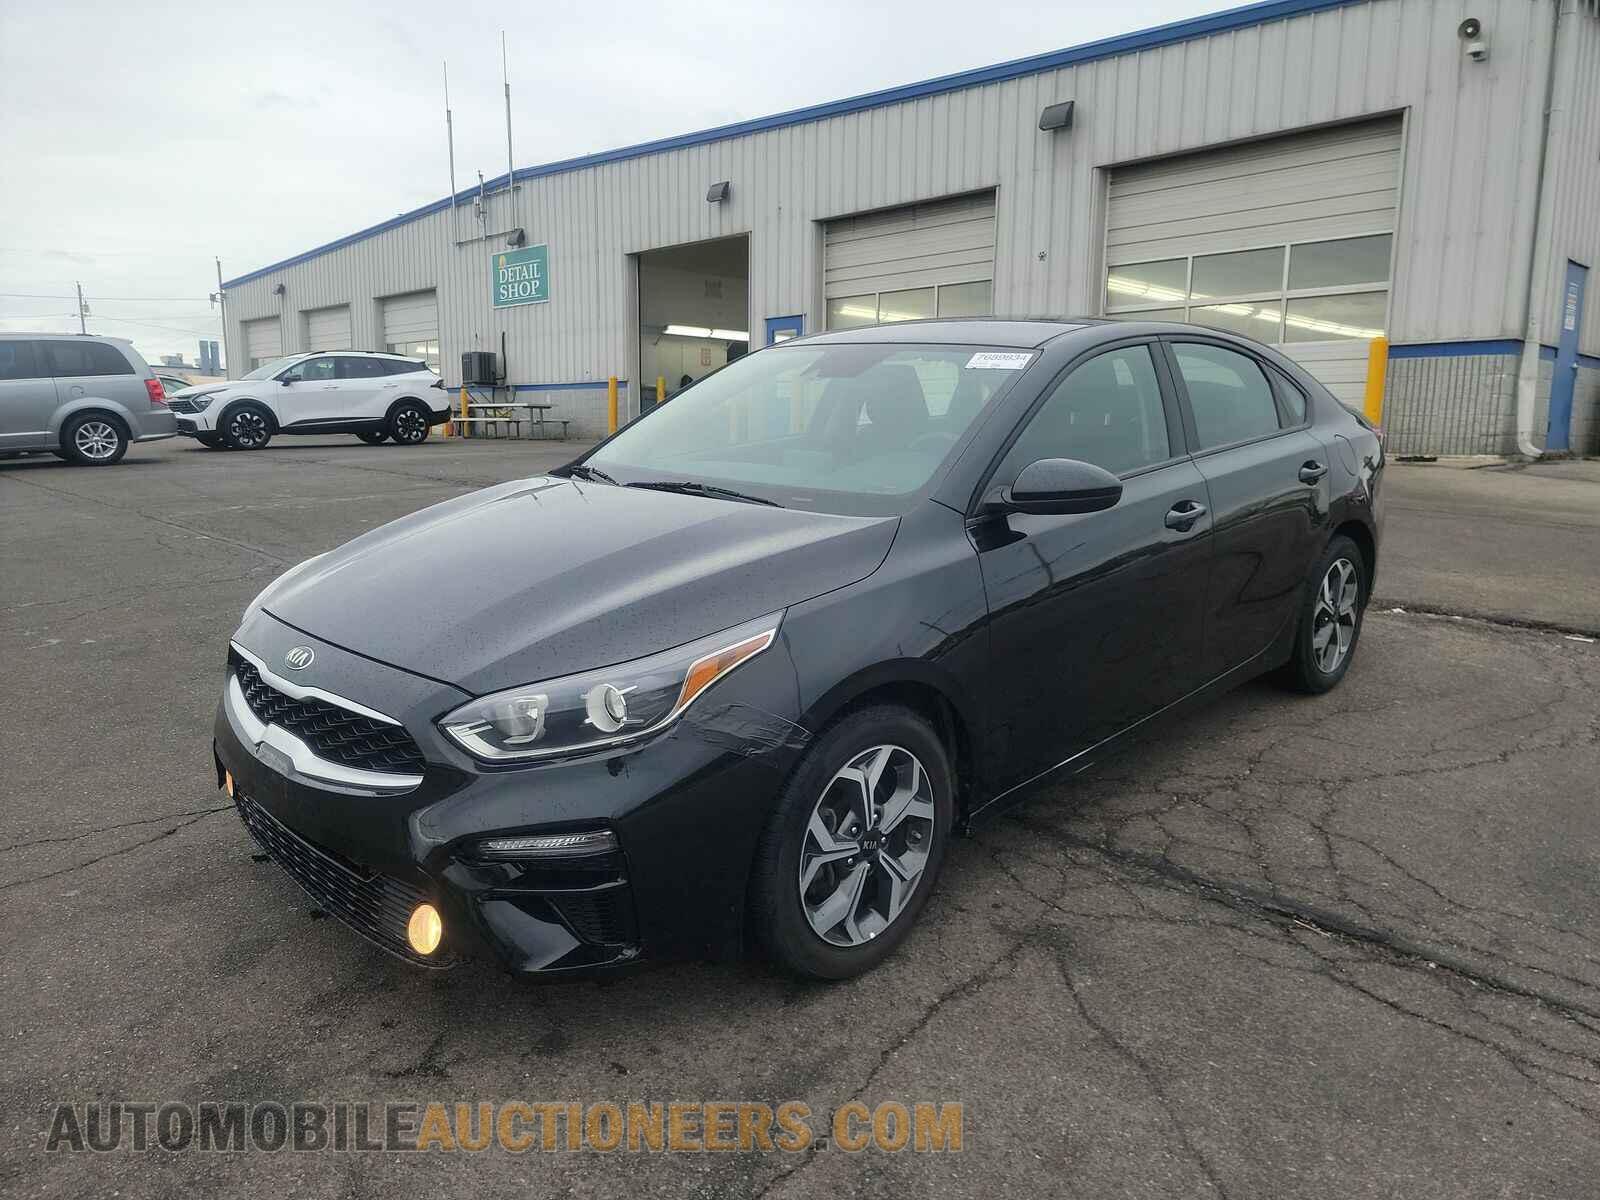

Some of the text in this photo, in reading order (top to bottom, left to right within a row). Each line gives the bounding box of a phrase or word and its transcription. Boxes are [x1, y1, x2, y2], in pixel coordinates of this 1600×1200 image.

[499, 263, 541, 284] DETAIL
[499, 280, 540, 299] SHOP
[863, 840, 877, 850] KIA
